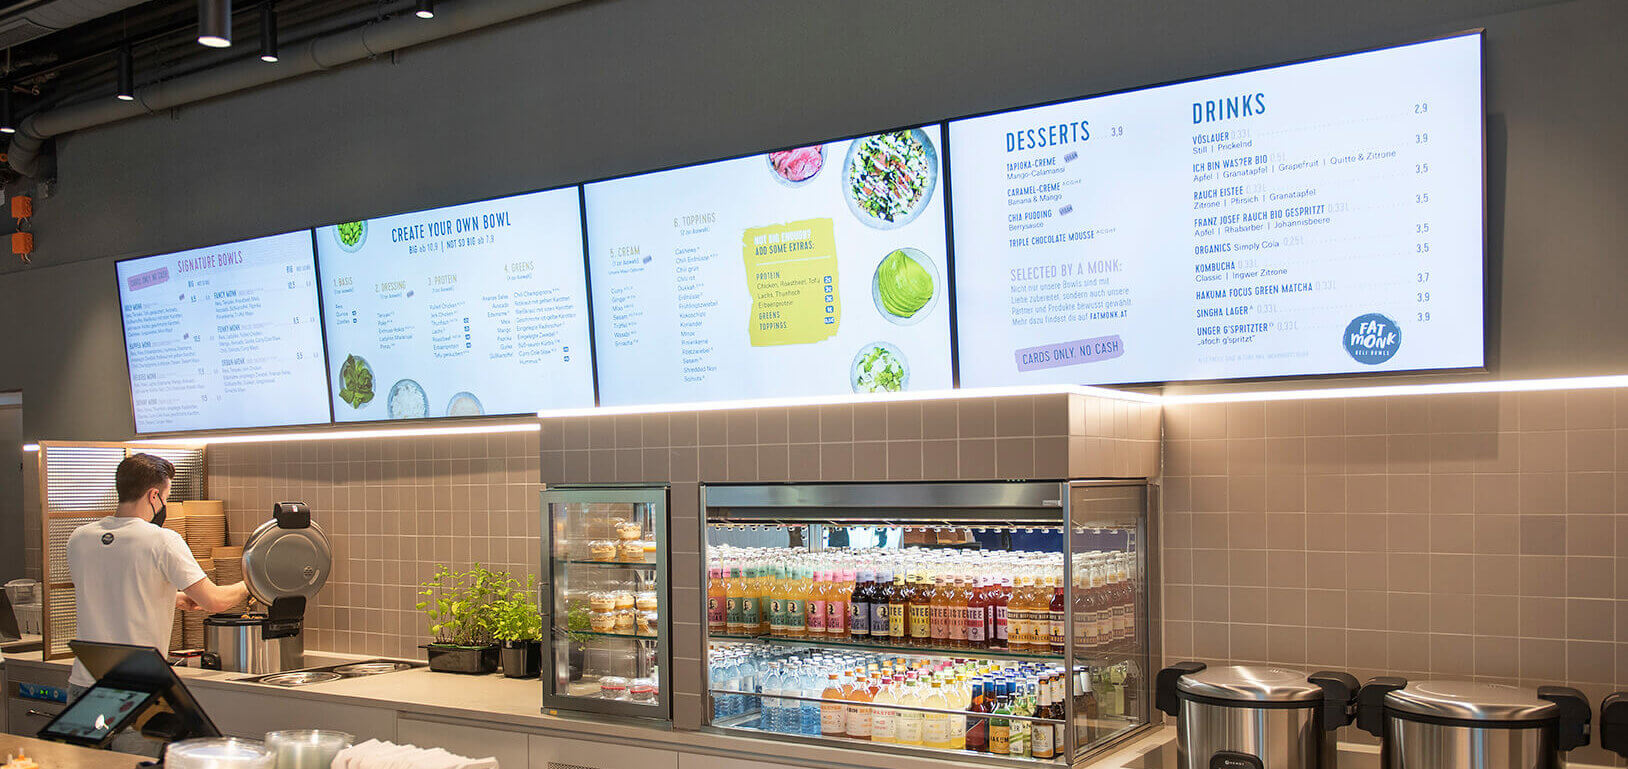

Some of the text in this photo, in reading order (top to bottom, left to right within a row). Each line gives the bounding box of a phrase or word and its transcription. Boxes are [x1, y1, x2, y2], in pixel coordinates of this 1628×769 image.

[1193, 93, 1266, 124] DRINKS
[1192, 103, 1428, 145] VÖSLAUER 2,9
[1006, 120, 1124, 152] DESSERTS 3,9
[1192, 140, 1252, 154] Still Prickelnd
[1192, 133, 1428, 173] ICH BIN WAS?ER BIO 3,9
[1006, 156, 1056, 172] TAPIOKA-CREME
[1193, 172, 1213, 183] Apfel
[1222, 166, 1268, 179] Granatapfel
[1278, 159, 1319, 173] Grapefruit
[1330, 154, 1357, 166] Quitte
[1366, 150, 1396, 160] Zitrone
[1006, 167, 1066, 180] Mango-Calamansi
[1194, 162, 1428, 200] RAUCH EISTEE 3,5
[1008, 196, 1032, 206] Banana
[1040, 193, 1062, 203] Mango
[1194, 188, 1316, 210] Zitrone Pfirsich Granatapfel
[682, 212, 716, 226] TOPPINGS
[1008, 212, 1022, 223] CHIA
[1024, 209, 1052, 221] PUDDING
[1194, 193, 1429, 228] FRANZ JOSEF RAUCH BIO GESPRITZT 3,5
[392, 211, 512, 243] CREATE YOUR OWN BOWL
[1194, 216, 1330, 238] Apfel Rhabarber Johannisbeere
[409, 244, 418, 254] BIG
[446, 238, 456, 249] NOT
[458, 238, 466, 248] SO
[466, 236, 476, 246] BIG
[756, 240, 814, 256] ADD SOME EXTRAS:
[1010, 238, 1030, 248] TRIPLE
[1032, 233, 1066, 246] CHOCOLATE
[1194, 223, 1429, 256] ORGANICS Simply Cola 3,5
[618, 245, 640, 257] CREAM
[1196, 243, 1430, 273] KOMBUCHA 3,5
[177, 250, 243, 274] SIGNATURE BOWLS
[512, 260, 535, 272] GREENS
[1010, 259, 1122, 282] SELECTED BY A MONK:
[434, 274, 458, 285] PROTEIN
[756, 272, 780, 280] PROTEIN
[1196, 267, 1288, 282] Classic Ingwer Zitrone
[1011, 278, 1110, 294] Nicht nur unsere Bowls sind mit
[1196, 272, 1430, 300] HAKUMA FOCUS GREEN MATCHA 3,7
[1012, 296, 1028, 304] Liebe
[1062, 291, 1088, 300] sondern
[1090, 289, 1106, 298] auch
[1108, 288, 1130, 296] unsere
[1012, 306, 1034, 316] Partner
[1035, 305, 1046, 314] und
[1048, 303, 1075, 312] Produkte
[1077, 301, 1104, 311] bewusst
[1196, 306, 1224, 318] SINGHA
[1416, 292, 1430, 303] 3,9
[758, 311, 780, 320] GREENS
[1012, 310, 1128, 326] Mehr dazu findest du auf FATMONK.AT
[1197, 324, 1222, 336] UNGER
[1417, 312, 1430, 323] 3,9
[760, 322, 788, 331] TOPPINGS
[1360, 320, 1387, 337] FAT
[1022, 350, 1050, 365] CARDS
[1080, 344, 1092, 357] NO
[1095, 341, 1119, 355] CASH
